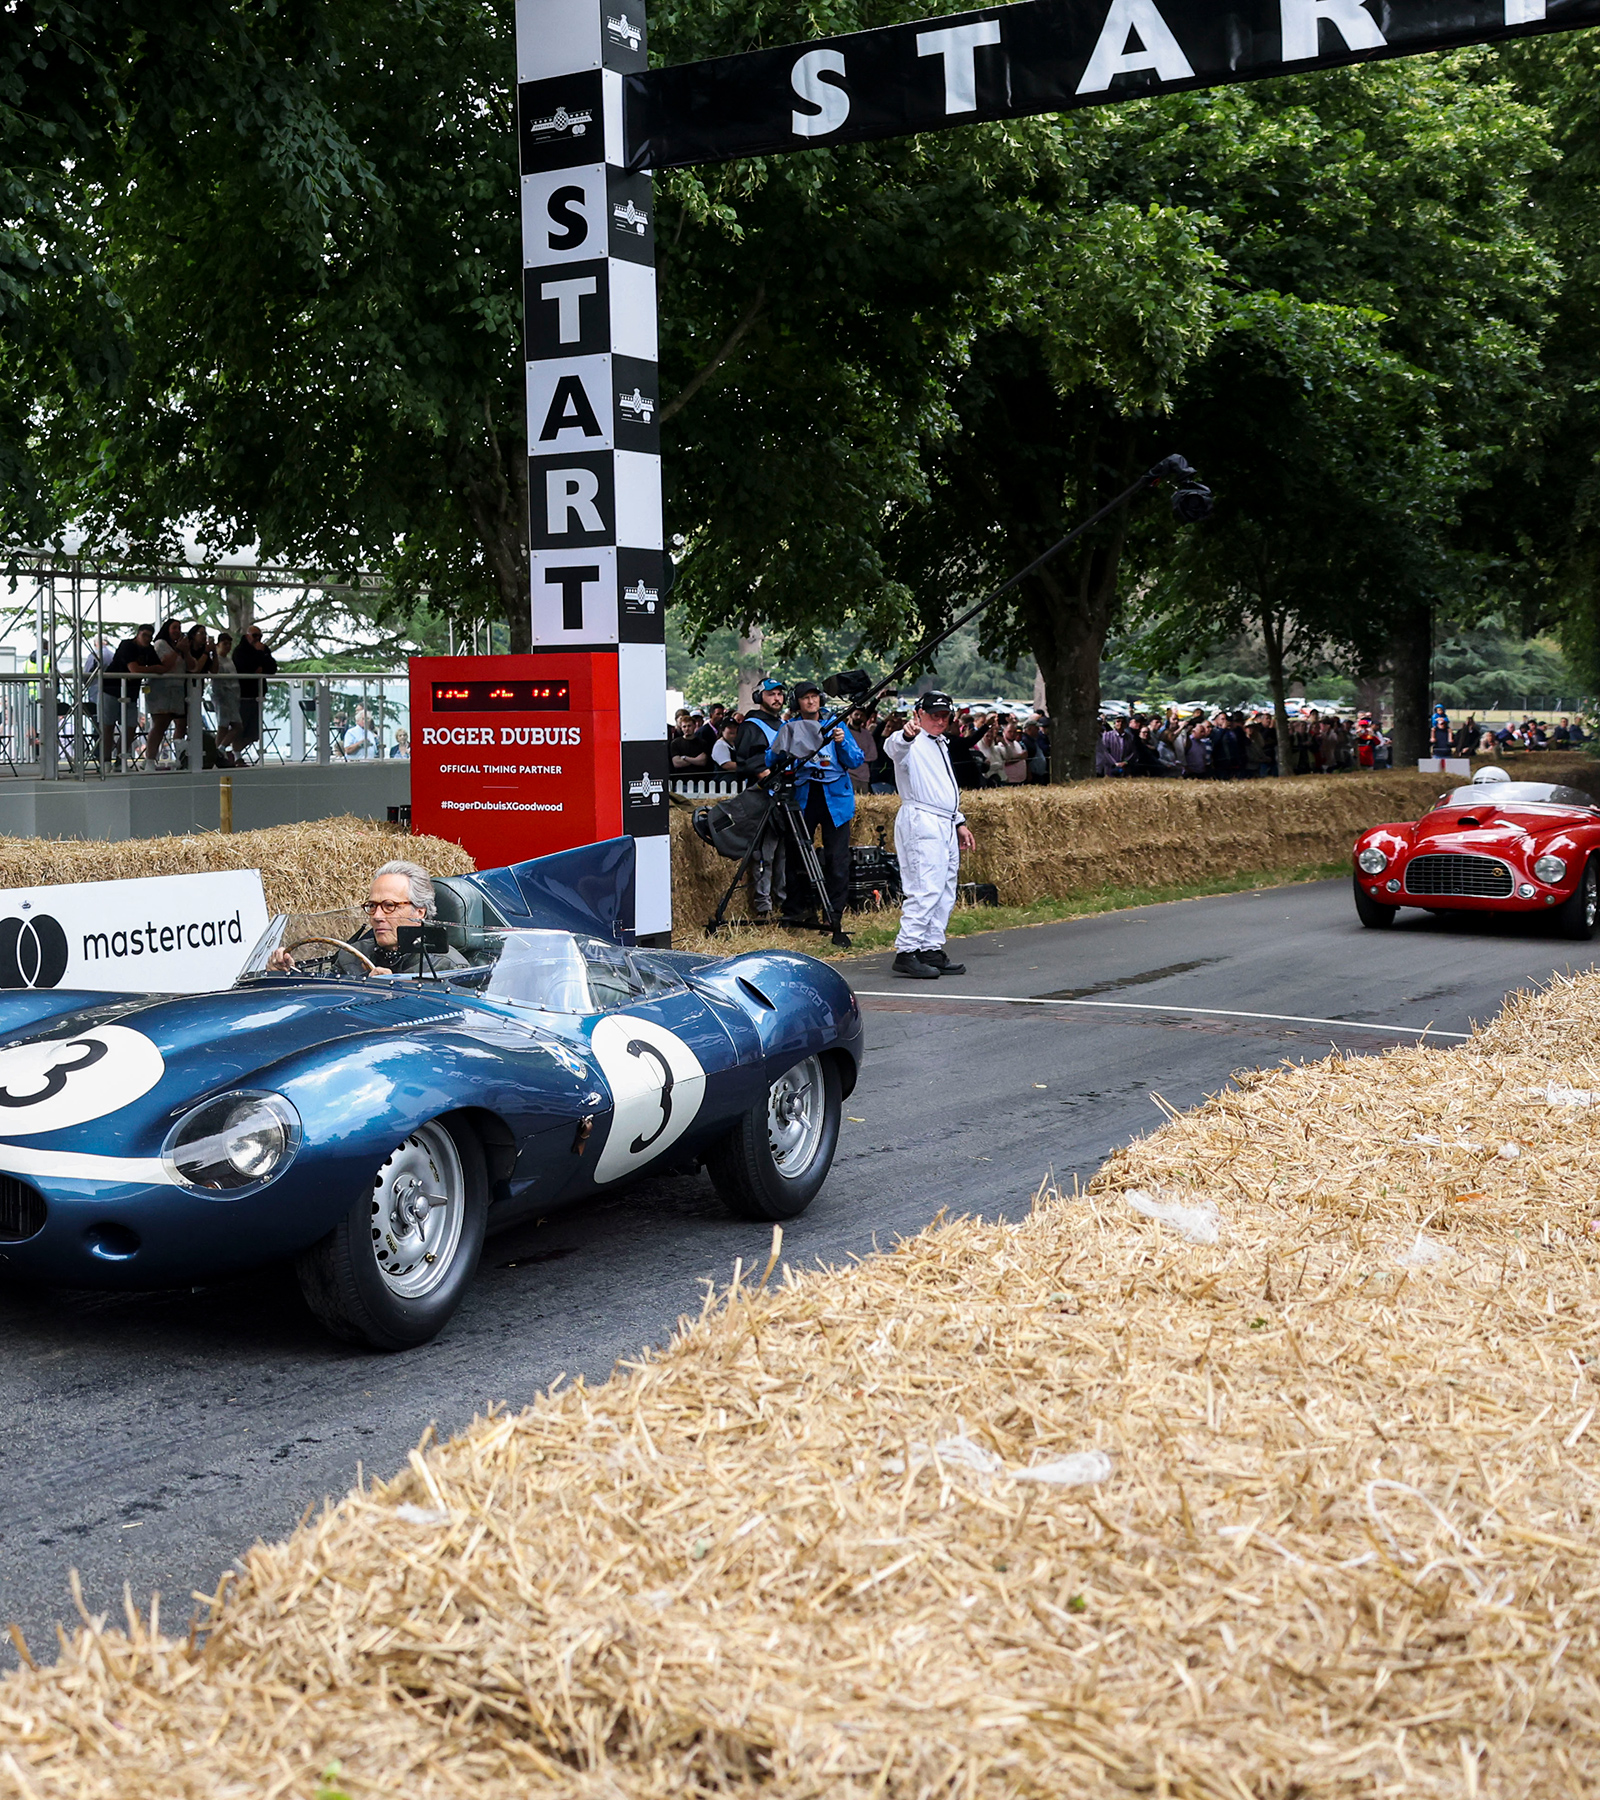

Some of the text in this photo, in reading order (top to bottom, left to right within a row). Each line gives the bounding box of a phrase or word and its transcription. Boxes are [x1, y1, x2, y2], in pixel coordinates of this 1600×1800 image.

[791, 0, 1547, 137] STAR
[538, 185, 605, 630] START
[422, 726, 581, 746] ROGER DUBUIS
[439, 764, 562, 775] OFFICIAL TIMING PARTNER
[441, 800, 563, 812] #RogerDubuisXGoodwood
[83, 909, 242, 961] mastercard
[626, 1039, 675, 1155] 3
